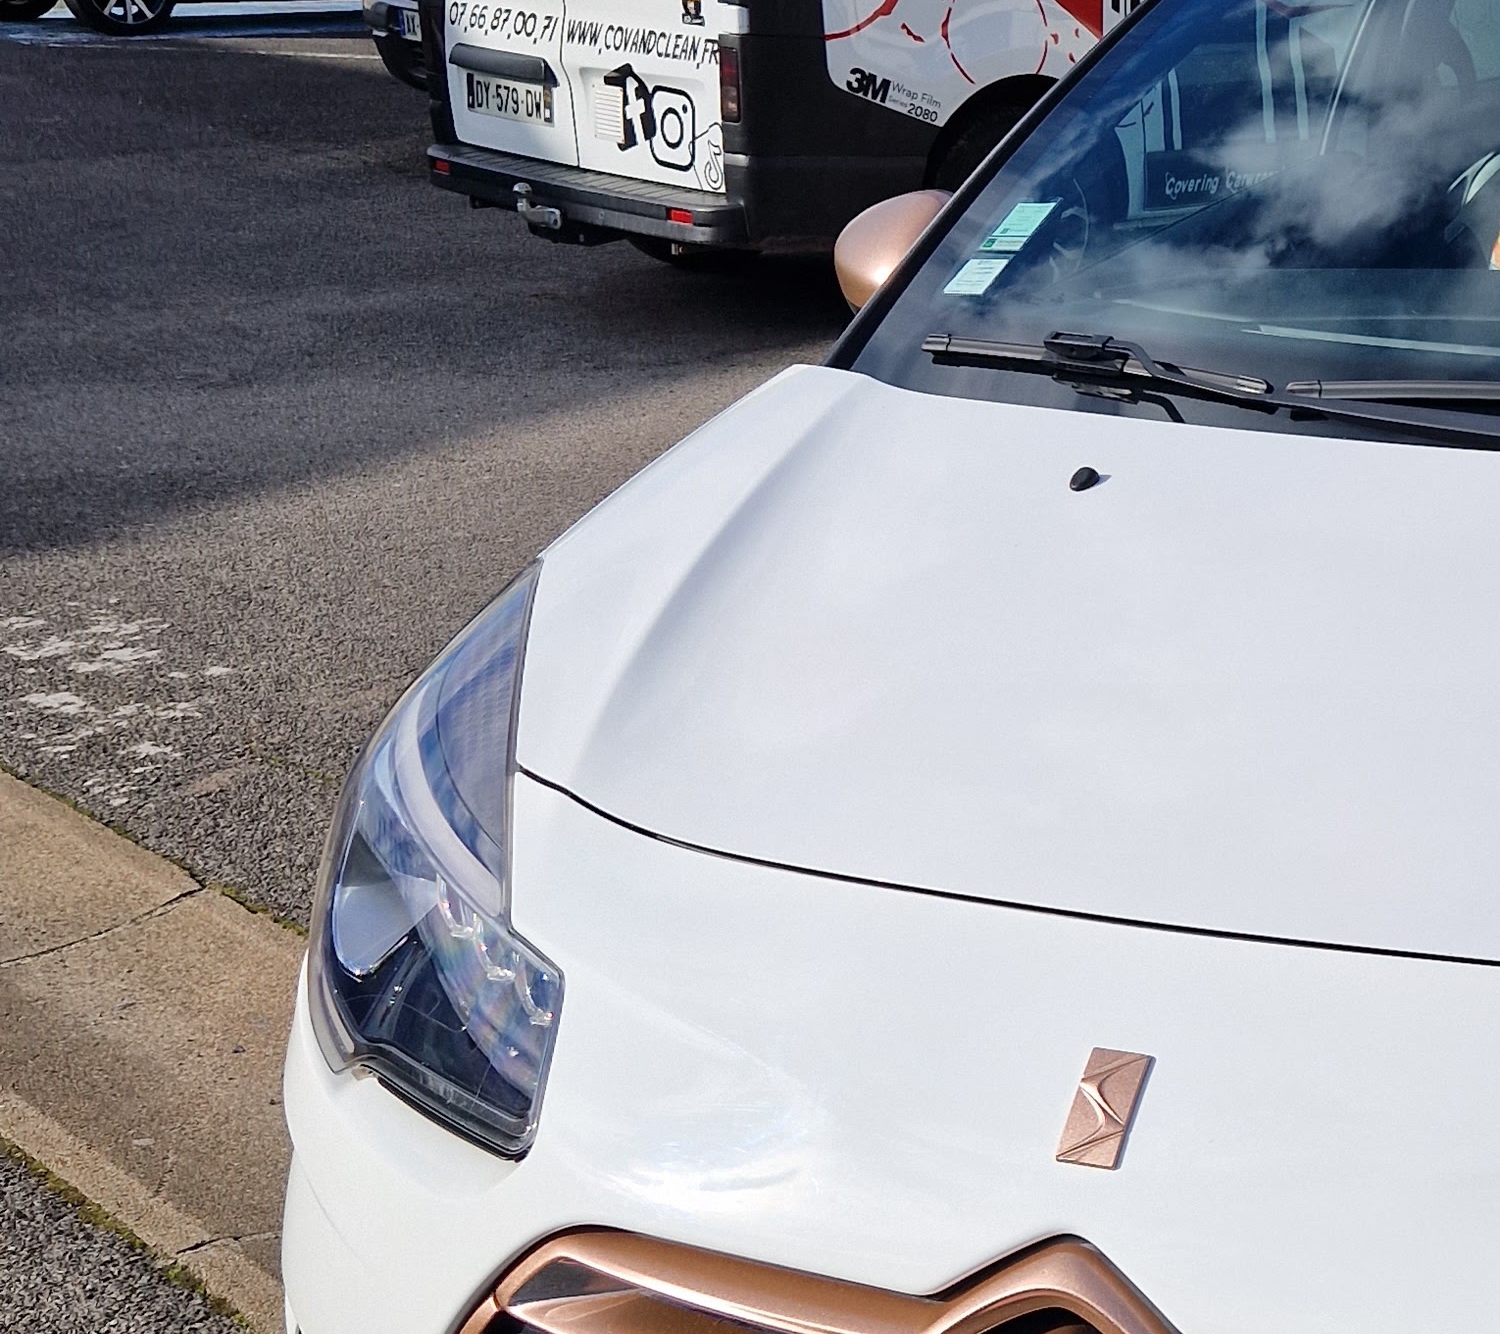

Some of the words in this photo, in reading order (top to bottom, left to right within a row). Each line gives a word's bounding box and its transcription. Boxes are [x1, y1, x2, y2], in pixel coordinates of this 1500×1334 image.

[566, 18, 720, 69] WWW.COVANDCLEAN.FR
[476, 79, 542, 120] DY-579-DW
[846, 67, 892, 104] 3M
[892, 80, 919, 102] Wrap
[921, 91, 942, 109] Film
[908, 102, 938, 123] 2080
[1165, 173, 1219, 200] Covering
